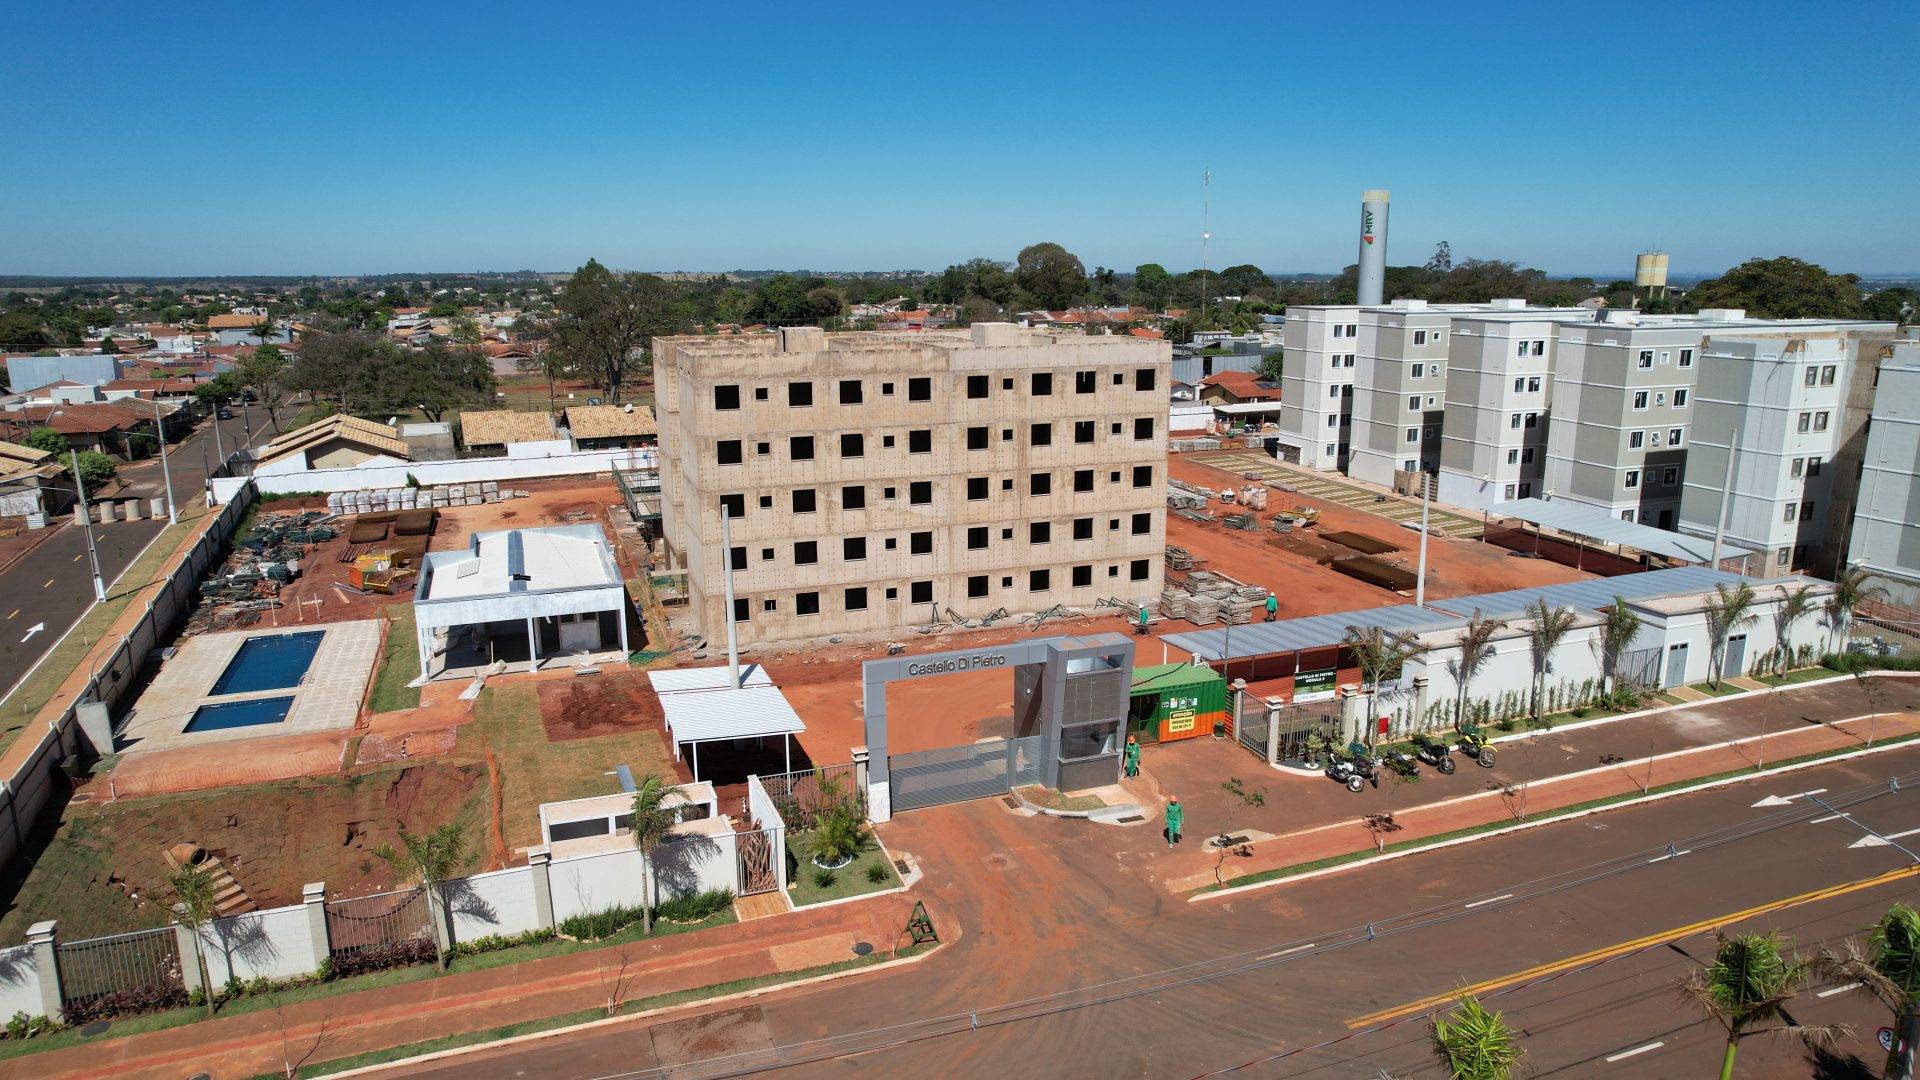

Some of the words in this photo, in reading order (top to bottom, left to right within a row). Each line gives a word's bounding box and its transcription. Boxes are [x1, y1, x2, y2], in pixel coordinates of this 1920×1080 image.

[1364, 210, 1374, 234] MRV
[908, 658, 956, 676] Castello
[958, 656, 970, 670] Di
[972, 654, 1006, 669] Pietro
